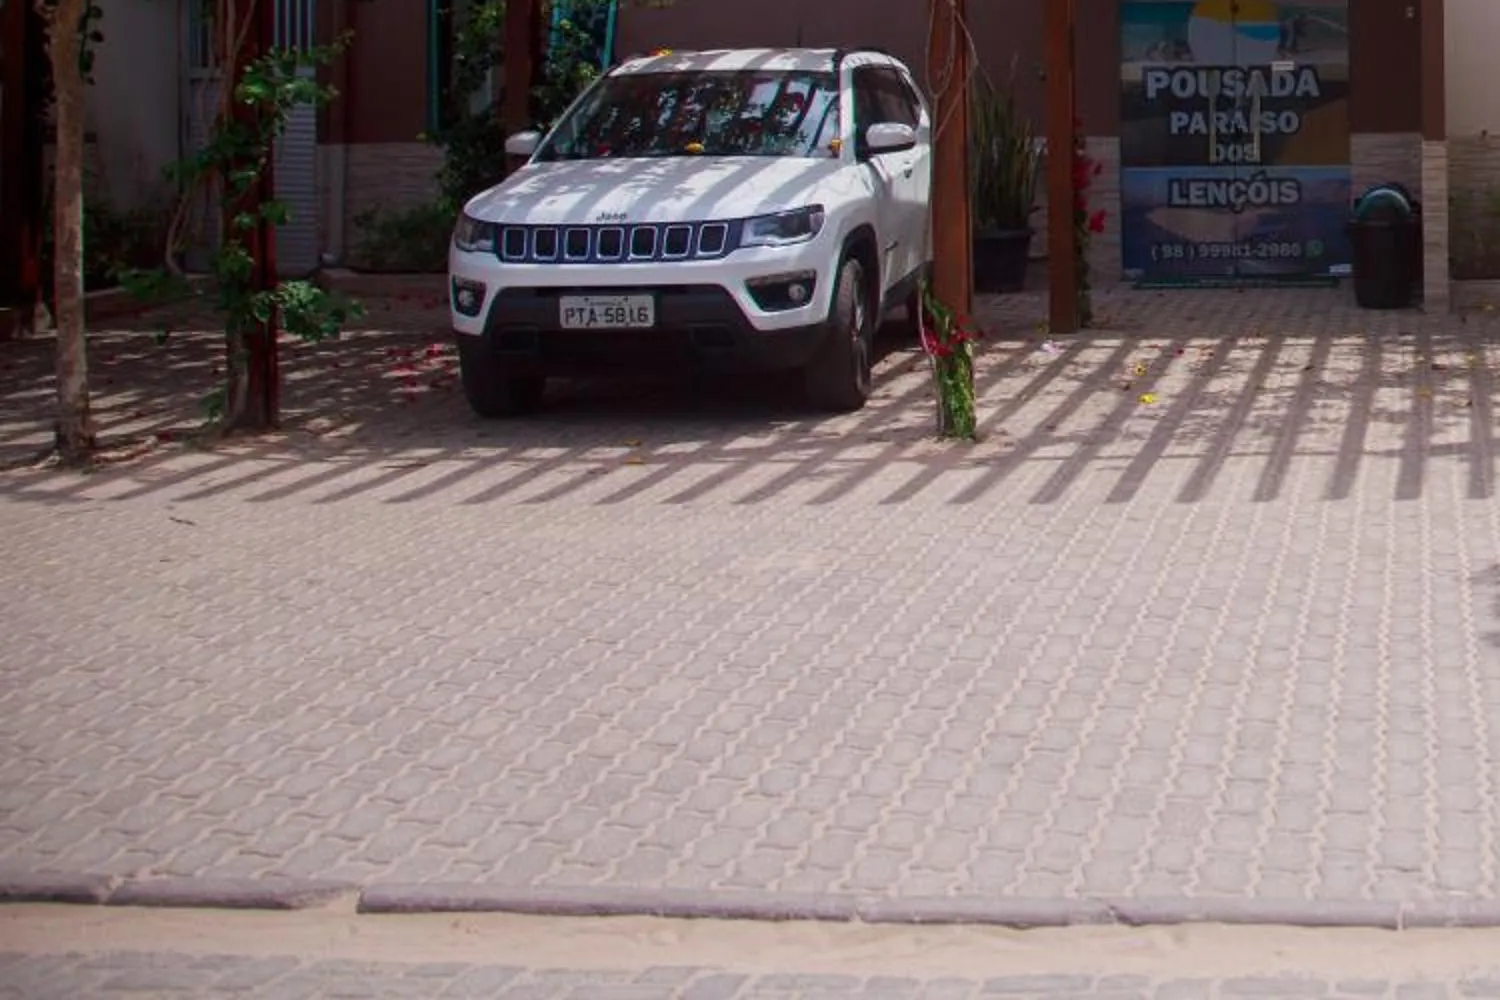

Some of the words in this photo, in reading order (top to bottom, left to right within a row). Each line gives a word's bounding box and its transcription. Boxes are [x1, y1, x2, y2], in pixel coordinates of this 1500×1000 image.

[1146, 68, 1321, 99] POUSADA
[1171, 174, 1300, 211] LENÇÓIS
[596, 211, 627, 223] Jeep
